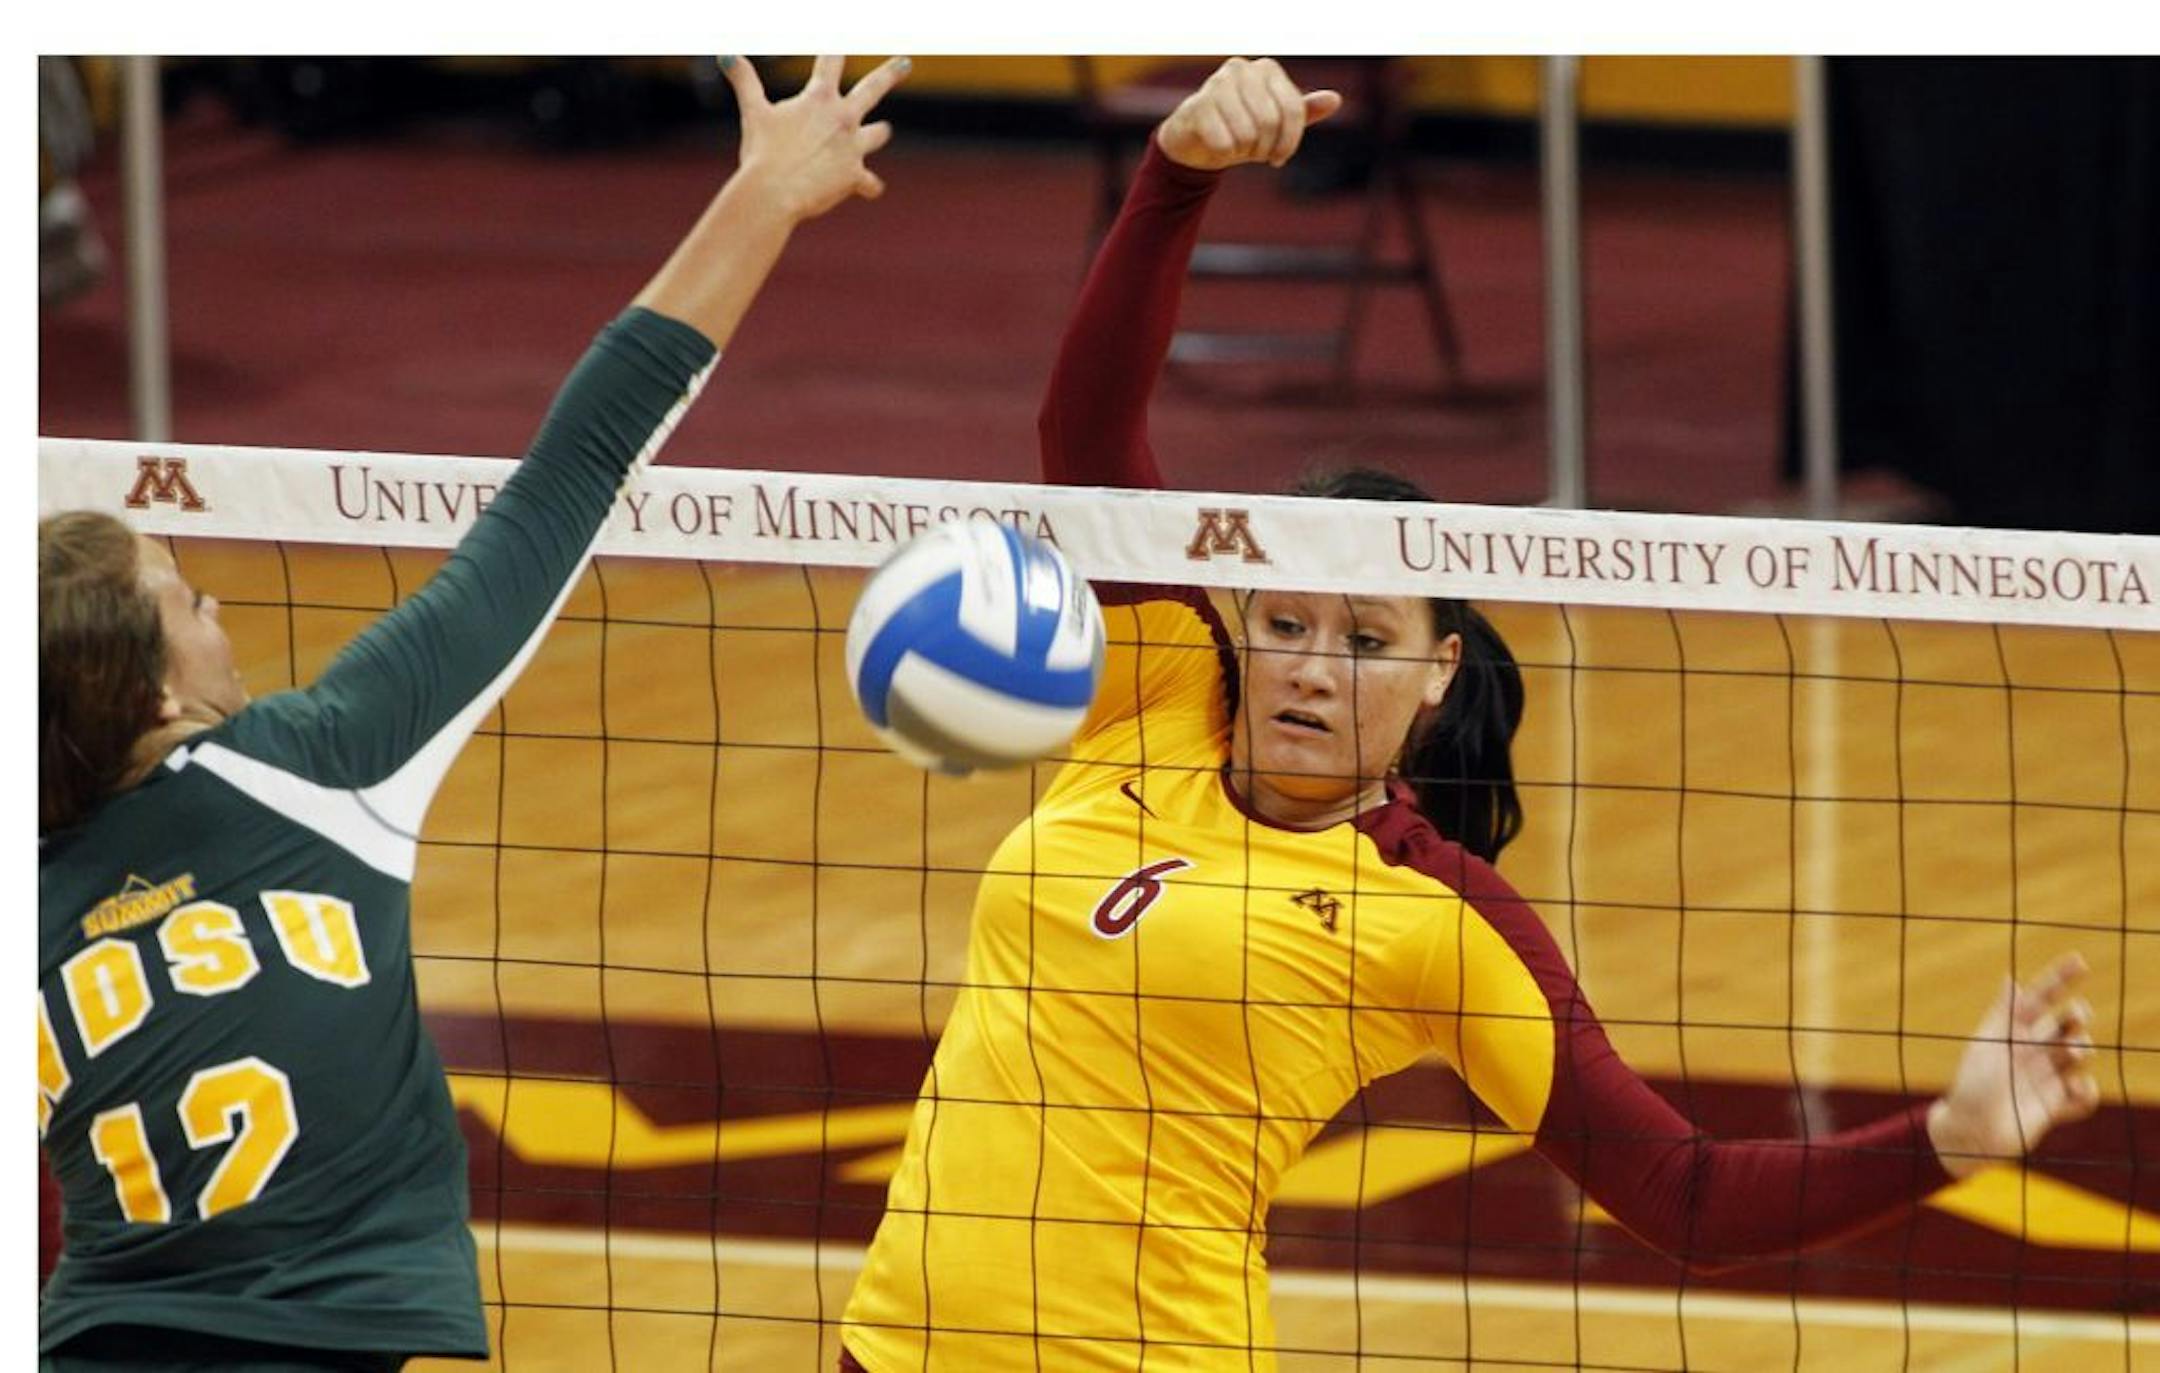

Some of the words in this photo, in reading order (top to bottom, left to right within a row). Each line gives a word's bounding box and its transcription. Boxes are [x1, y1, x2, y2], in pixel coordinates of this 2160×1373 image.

[328, 465, 651, 532] UNIVEY
[670, 492, 734, 536] OF
[1394, 516, 1726, 585] UNIVERSITY
[1745, 544, 1811, 588] OF
[1830, 536, 2153, 605] MINNESOTA
[1091, 857, 1197, 940] 6
[89, 1055, 300, 1224] 12
